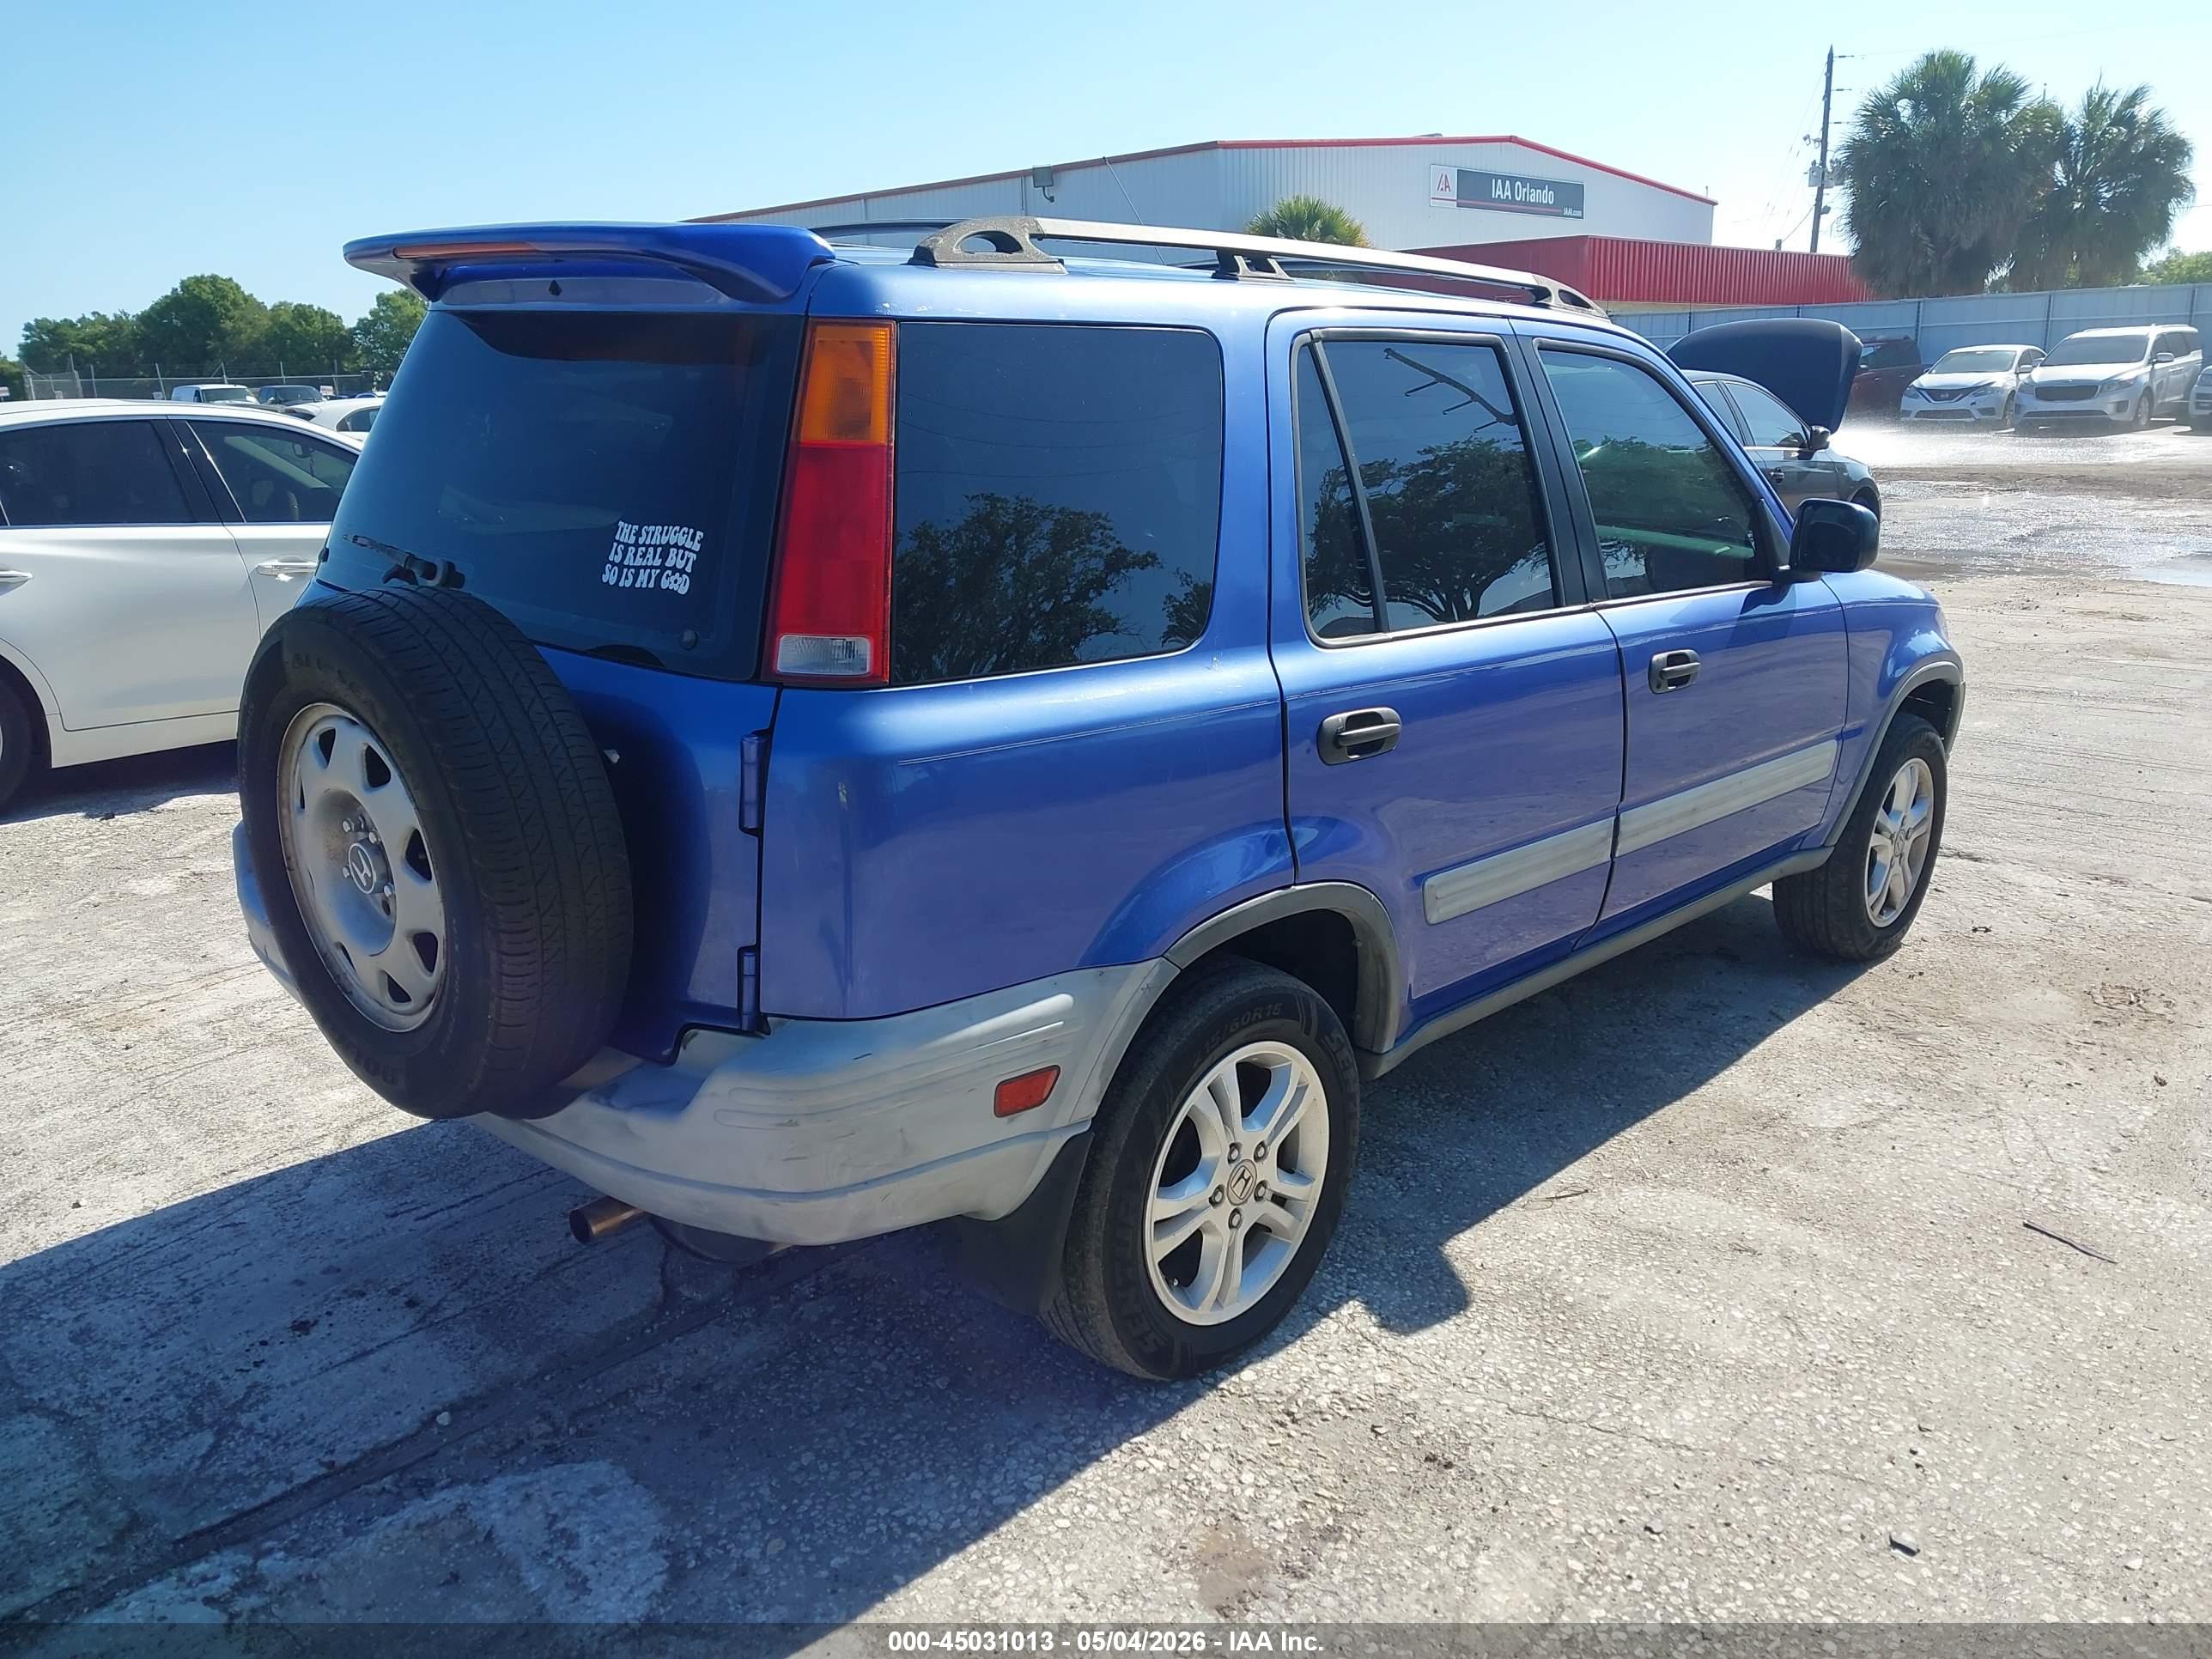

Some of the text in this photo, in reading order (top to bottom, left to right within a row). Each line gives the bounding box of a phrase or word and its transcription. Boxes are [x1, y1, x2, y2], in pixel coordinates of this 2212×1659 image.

[1492, 178, 1555, 205] IAA Orlando
[615, 520, 704, 551] THE STRUGGLE
[608, 542, 697, 573] IS REAL BUT
[602, 563, 618, 586] SO
[618, 568, 635, 587] IS
[635, 568, 660, 588] MY
